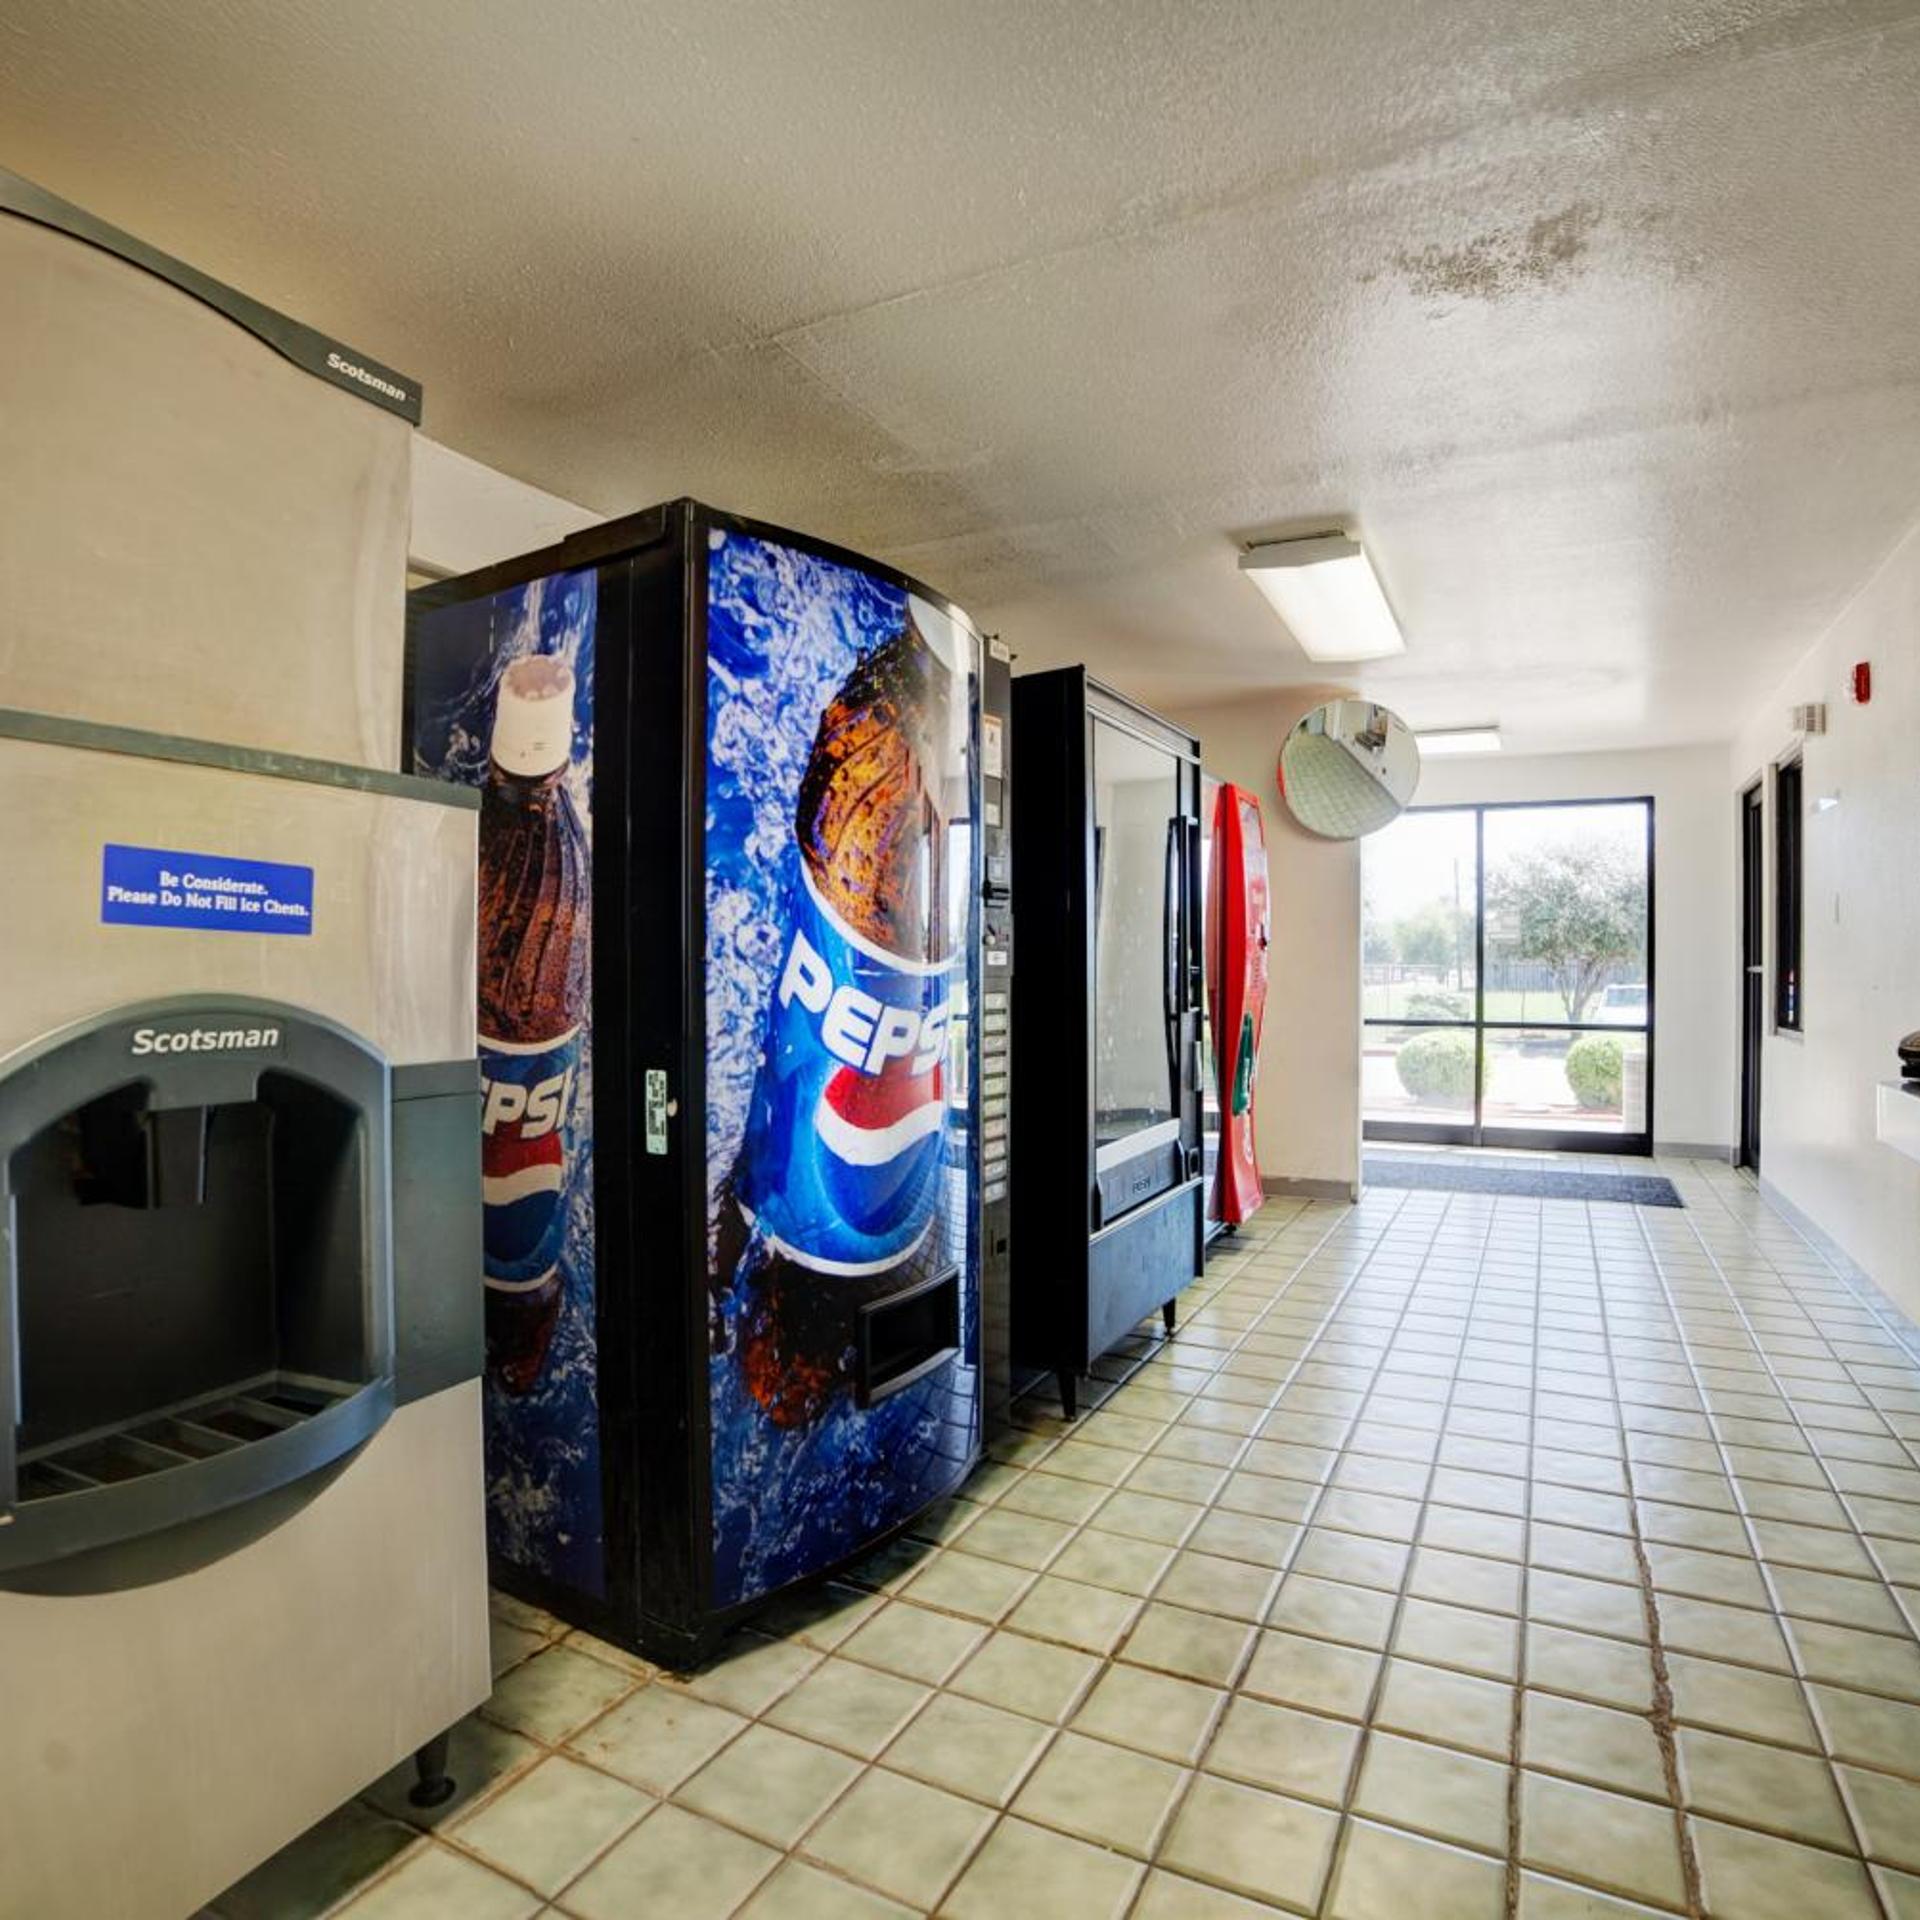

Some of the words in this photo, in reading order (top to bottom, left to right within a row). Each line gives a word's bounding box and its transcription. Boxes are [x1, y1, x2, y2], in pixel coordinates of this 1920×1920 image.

[327, 353, 406, 402] Scotsman
[160, 871, 178, 887] Be
[183, 873, 269, 895] Considerate.
[107, 886, 157, 905] Please
[161, 891, 182, 906] Do
[185, 894, 212, 909] Not
[215, 895, 237, 911] Fill
[240, 898, 260, 913] Ice
[263, 899, 309, 916] Chests.
[131, 1028, 279, 1055] Scotsman
[480, 1066, 573, 1139] PSI
